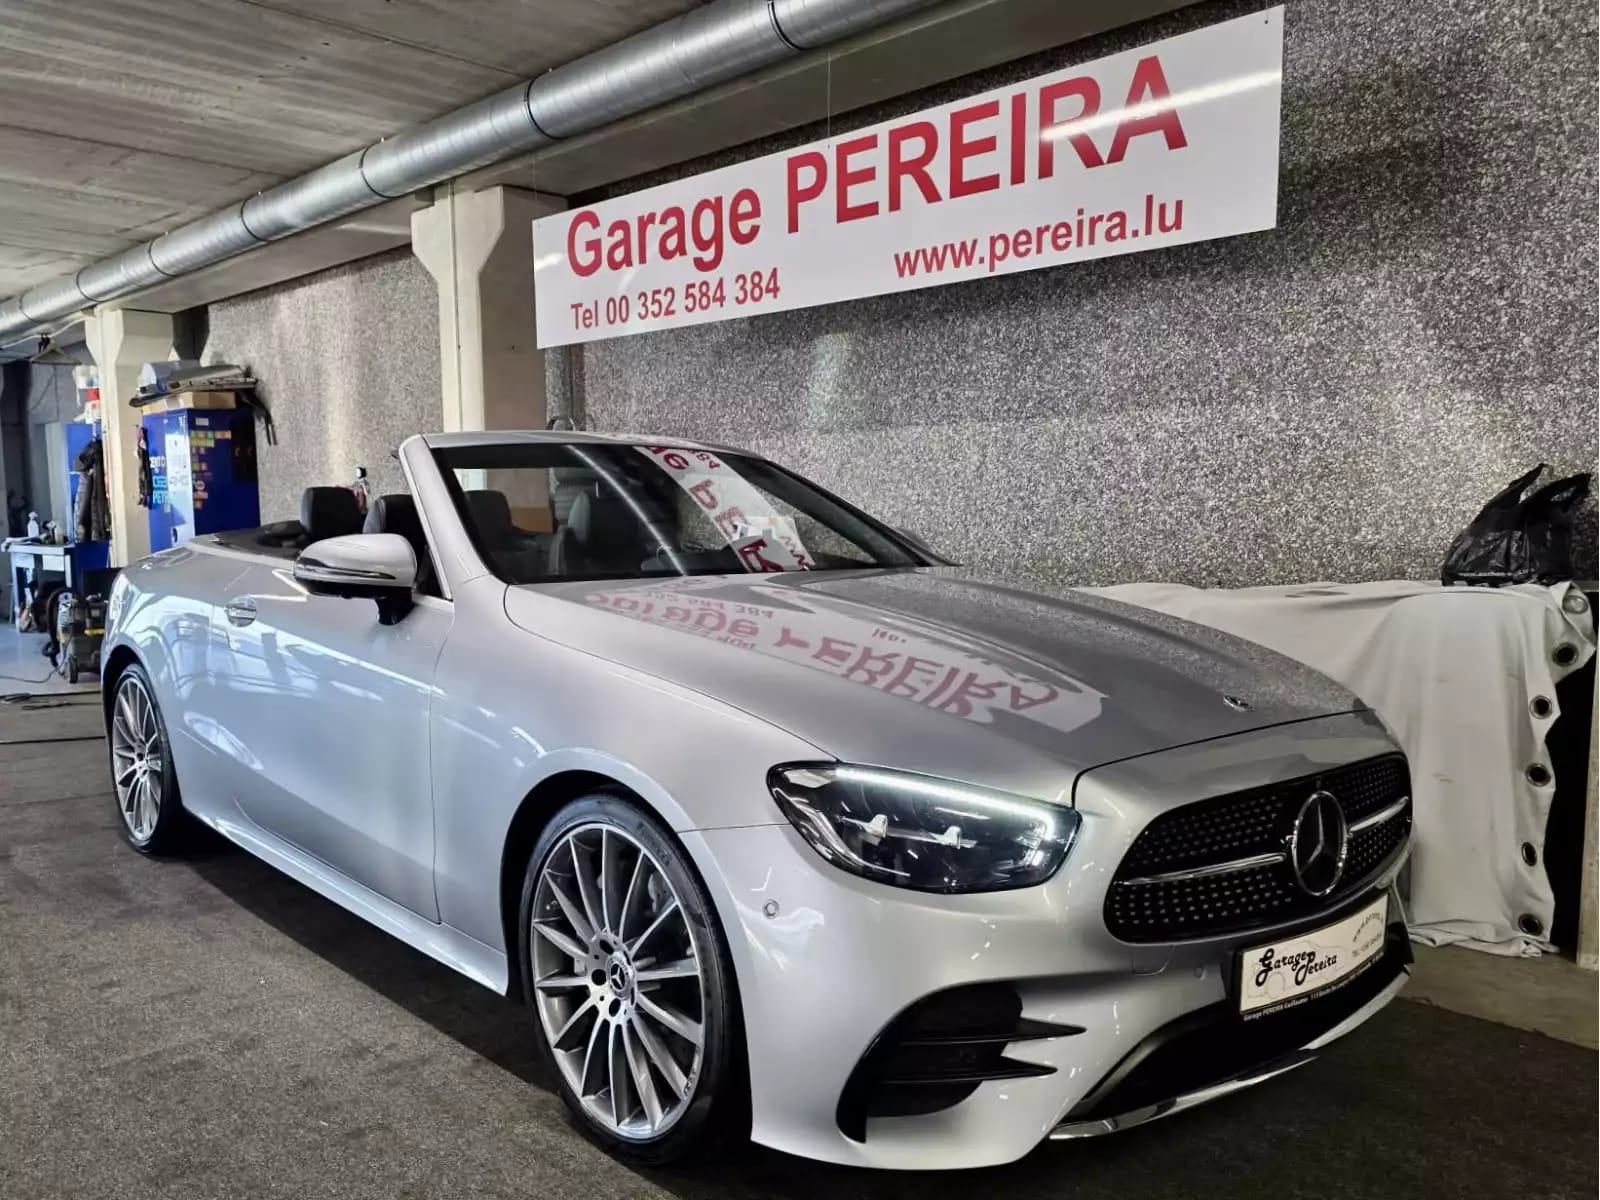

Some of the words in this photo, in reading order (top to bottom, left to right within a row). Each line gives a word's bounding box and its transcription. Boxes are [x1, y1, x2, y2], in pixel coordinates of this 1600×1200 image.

[566, 187, 762, 277] Garage
[786, 54, 1189, 235] PEREIRA
[893, 193, 1184, 279] www.pereira.lu
[570, 299, 599, 331] Tel
[605, 294, 631, 326] 00
[637, 286, 676, 321] 352
[684, 276, 727, 313] 584
[734, 266, 781, 306] 384
[1255, 947, 1308, 987] Garage
[1294, 950, 1338, 986] Pereira
